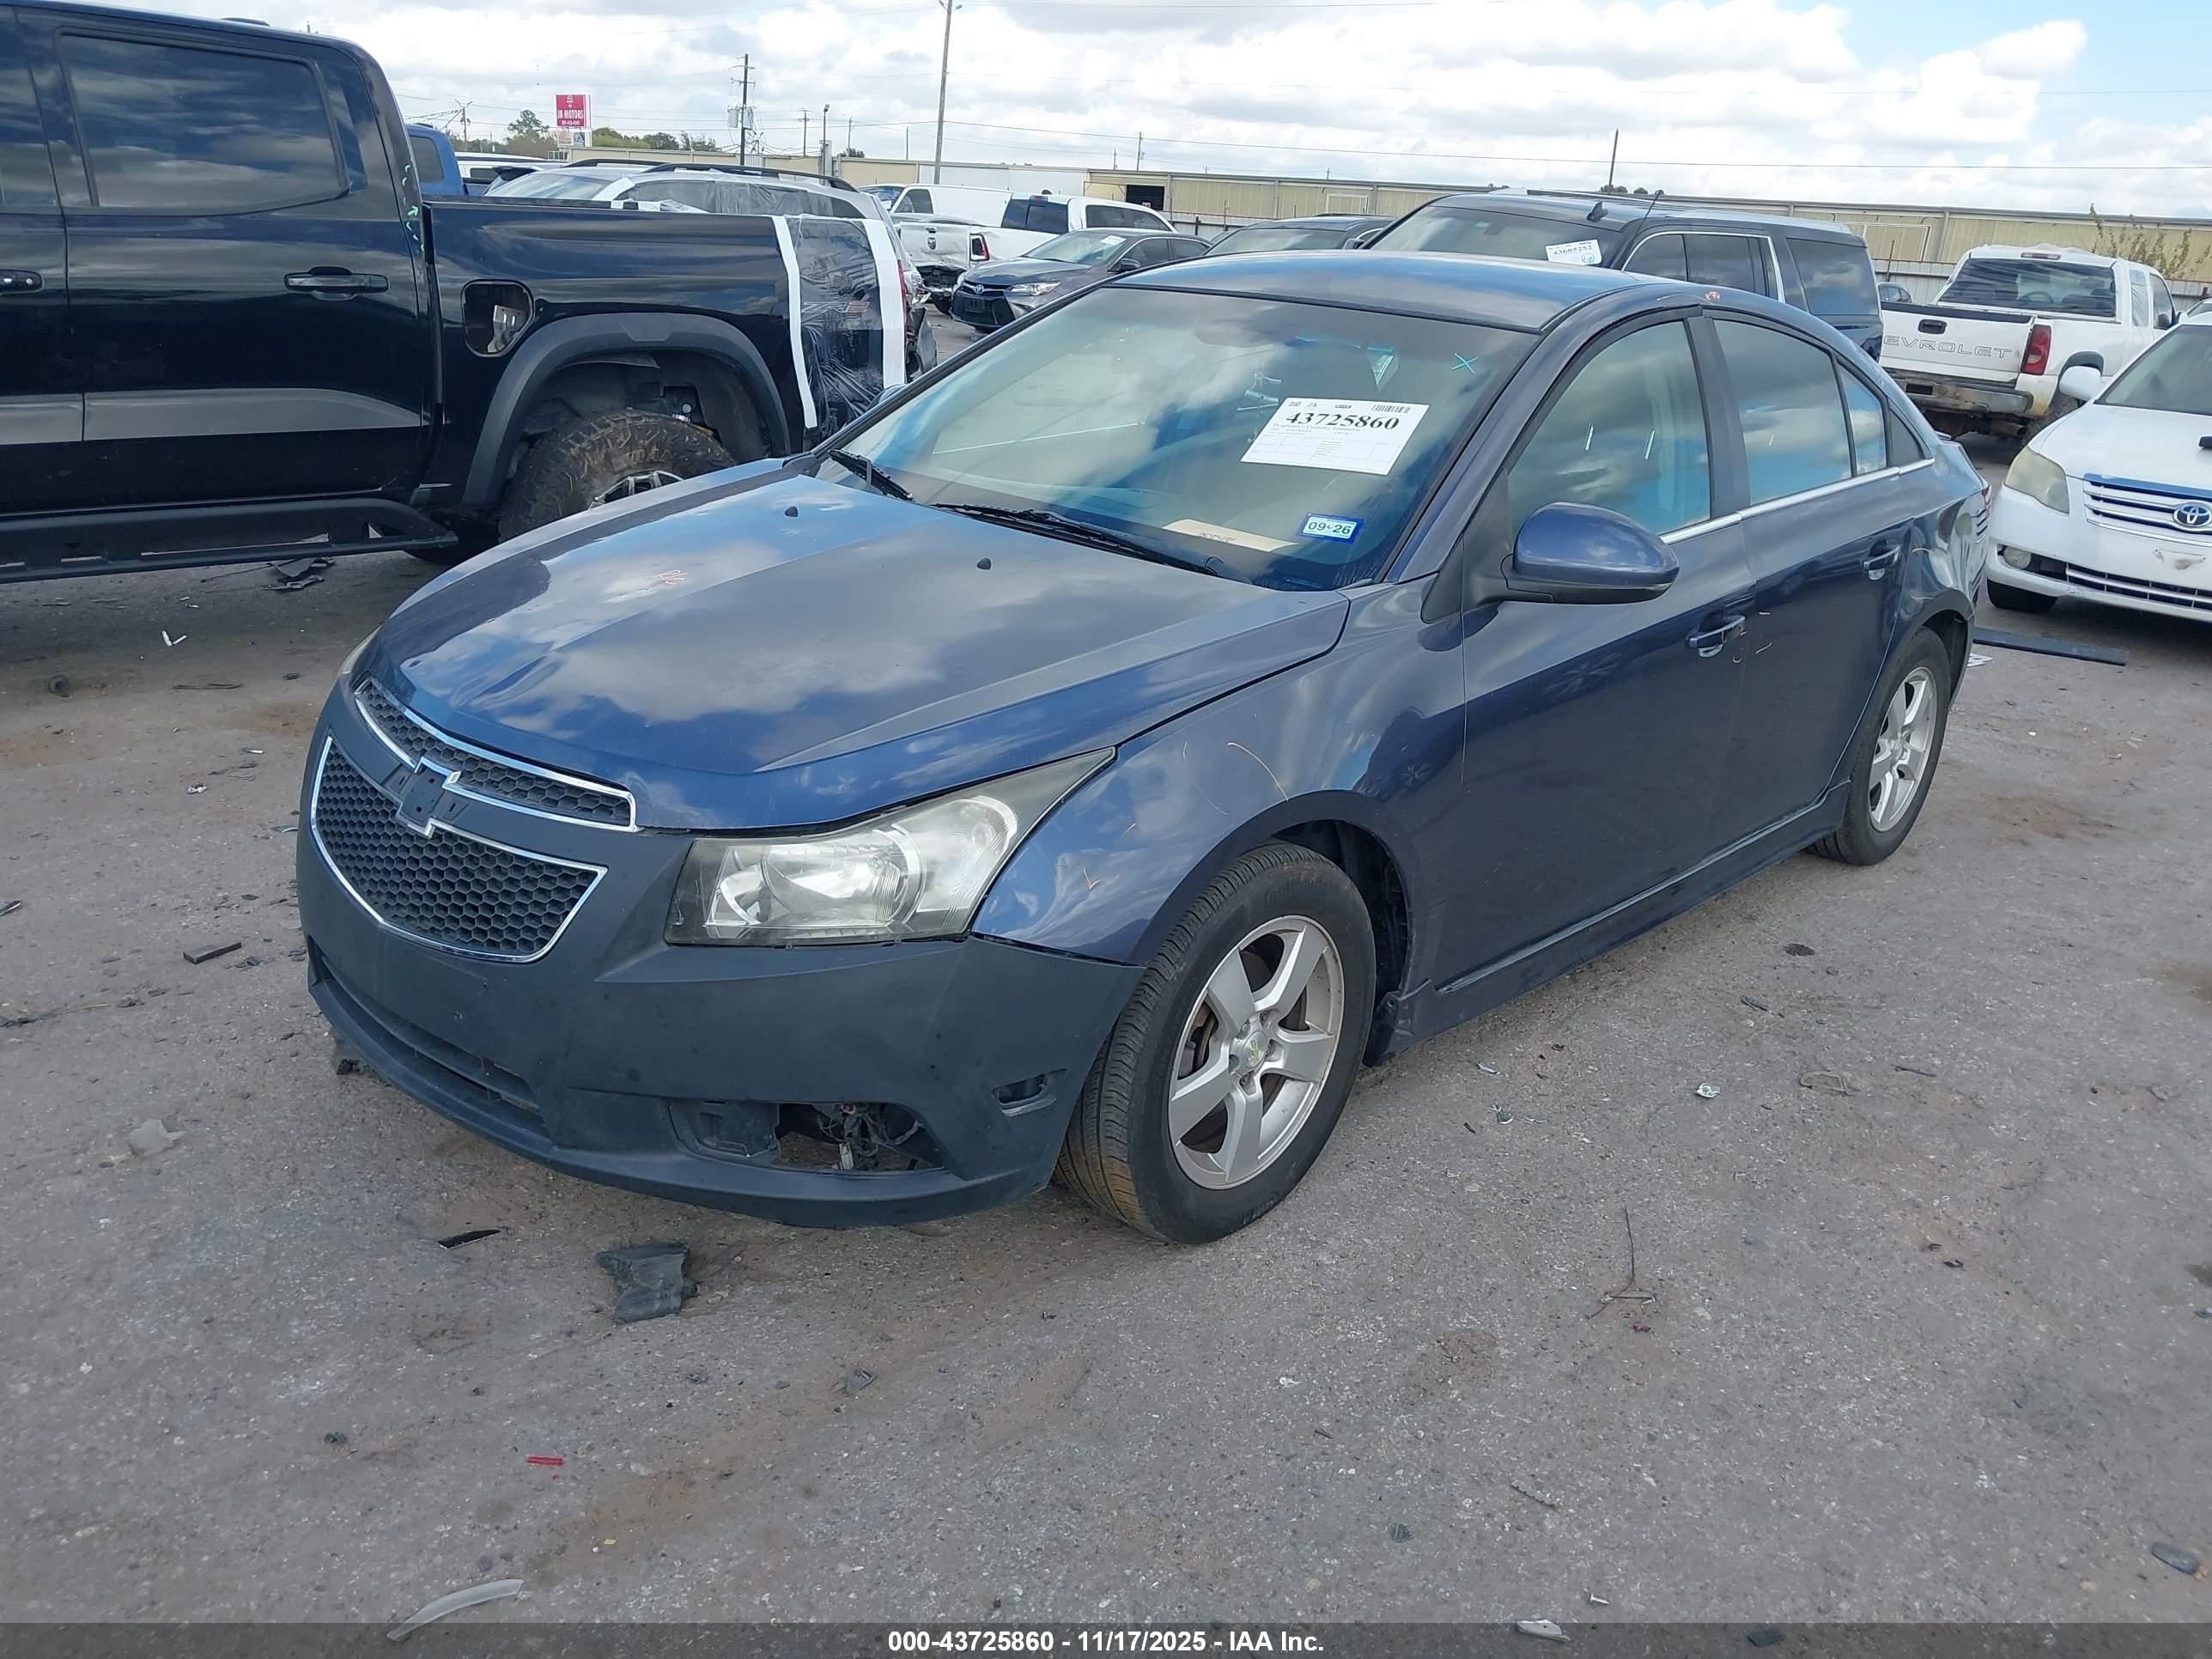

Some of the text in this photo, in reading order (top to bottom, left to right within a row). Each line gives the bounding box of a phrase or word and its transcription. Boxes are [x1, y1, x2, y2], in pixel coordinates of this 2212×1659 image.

[564, 110, 584, 119] MOTORS
[1285, 411, 1401, 430] 43725860
[1308, 521, 1352, 534] 09 26
